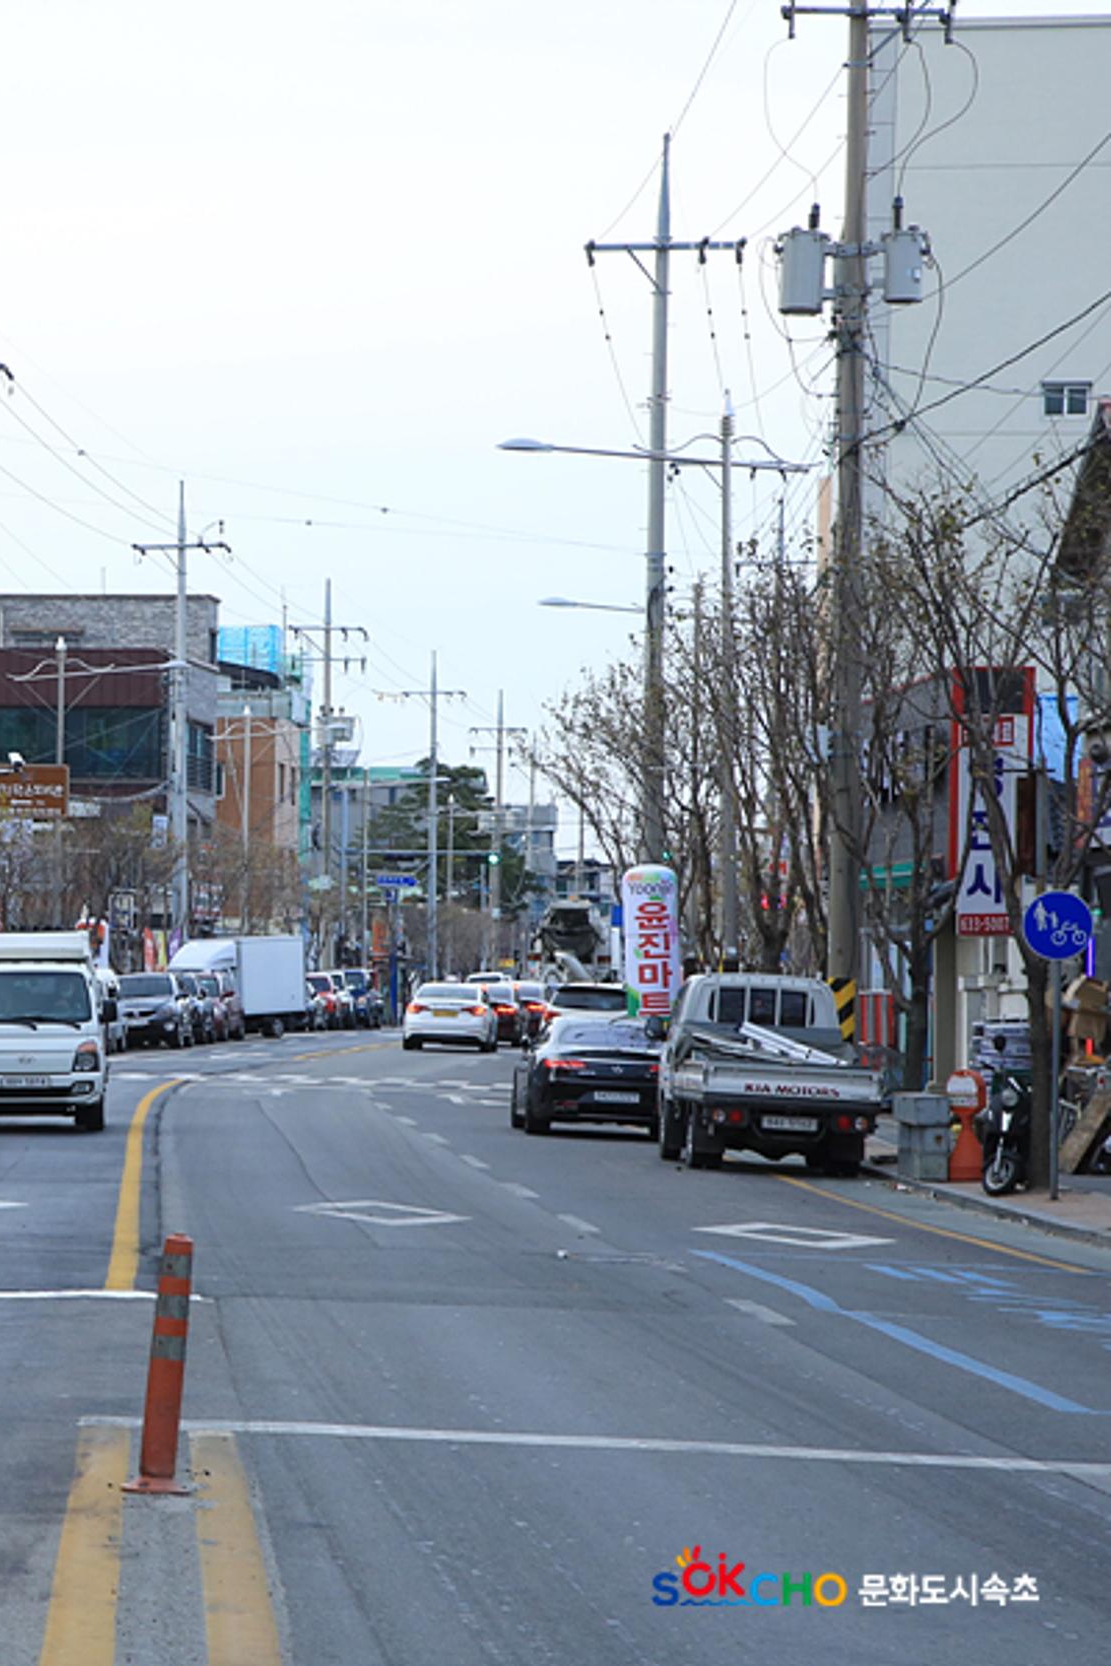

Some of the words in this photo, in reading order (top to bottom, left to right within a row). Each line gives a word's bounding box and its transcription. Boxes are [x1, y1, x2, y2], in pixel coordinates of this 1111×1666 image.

[635, 901, 674, 1017] 윤진마트
[744, 1082, 770, 1094] KIA
[775, 1084, 841, 1098] MOTORS
